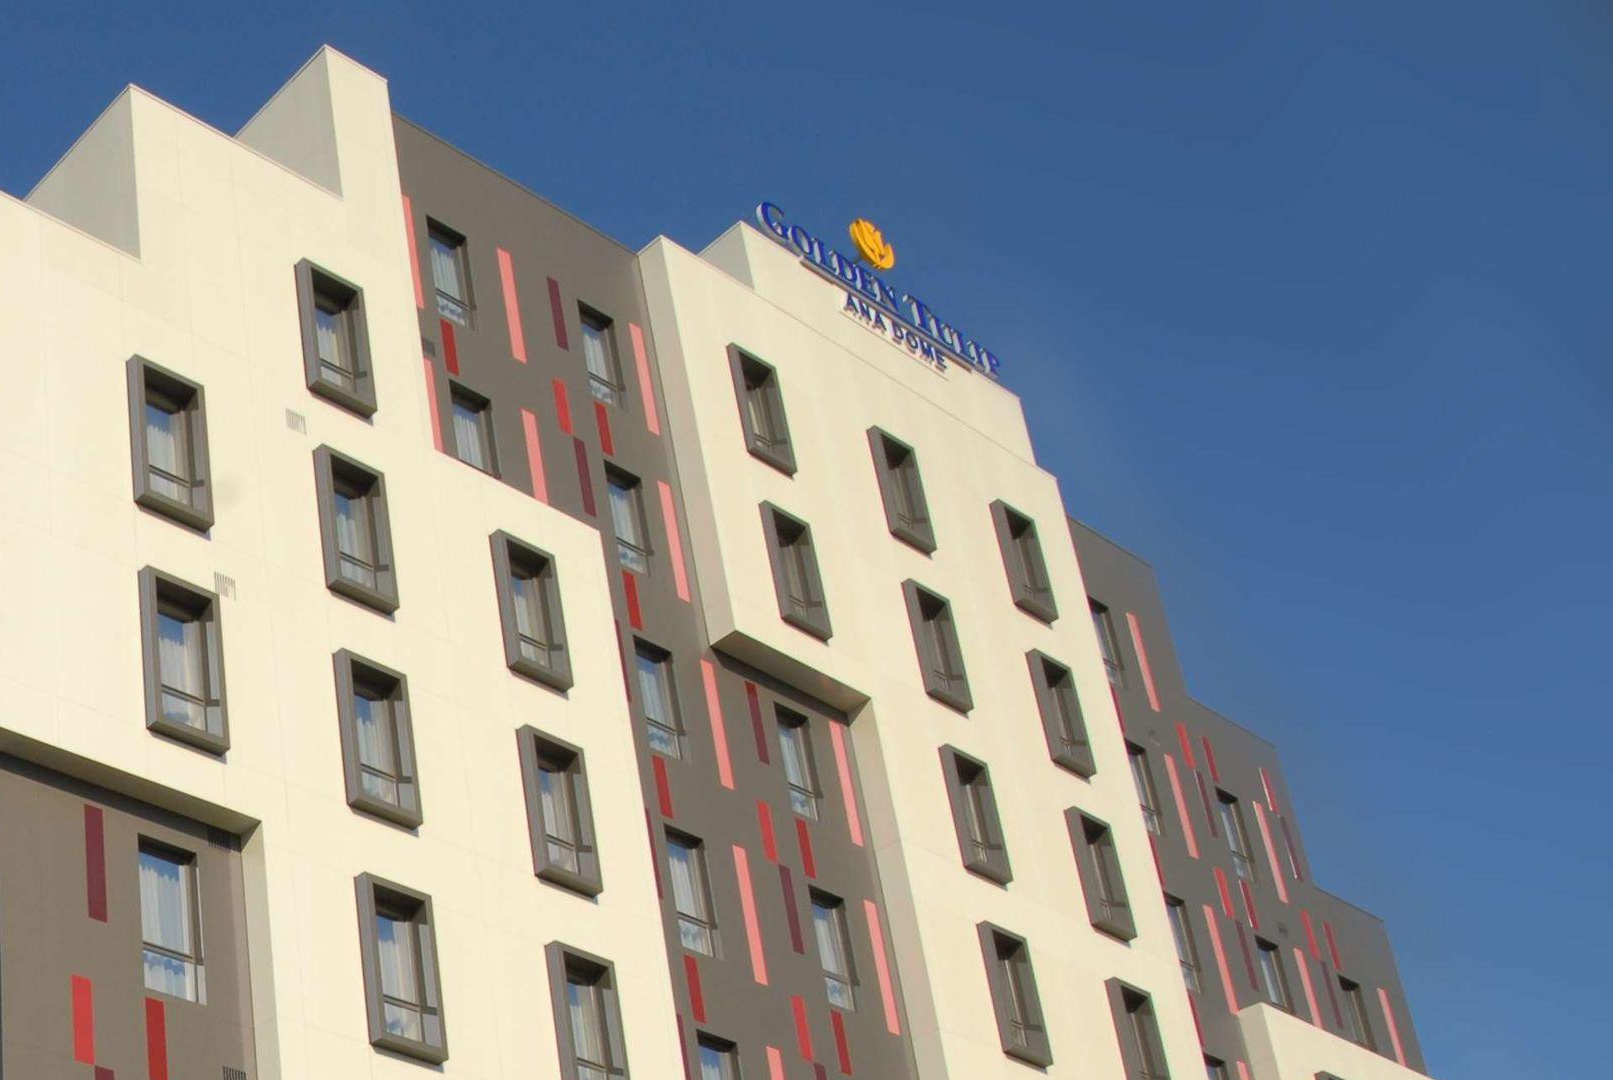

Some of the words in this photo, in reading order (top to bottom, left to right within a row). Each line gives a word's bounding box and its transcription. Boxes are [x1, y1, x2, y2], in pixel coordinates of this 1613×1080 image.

[756, 201, 898, 312] GOLDEN
[902, 294, 1000, 378] TULIP
[843, 292, 887, 334] ANA
[889, 319, 948, 373] DOME
